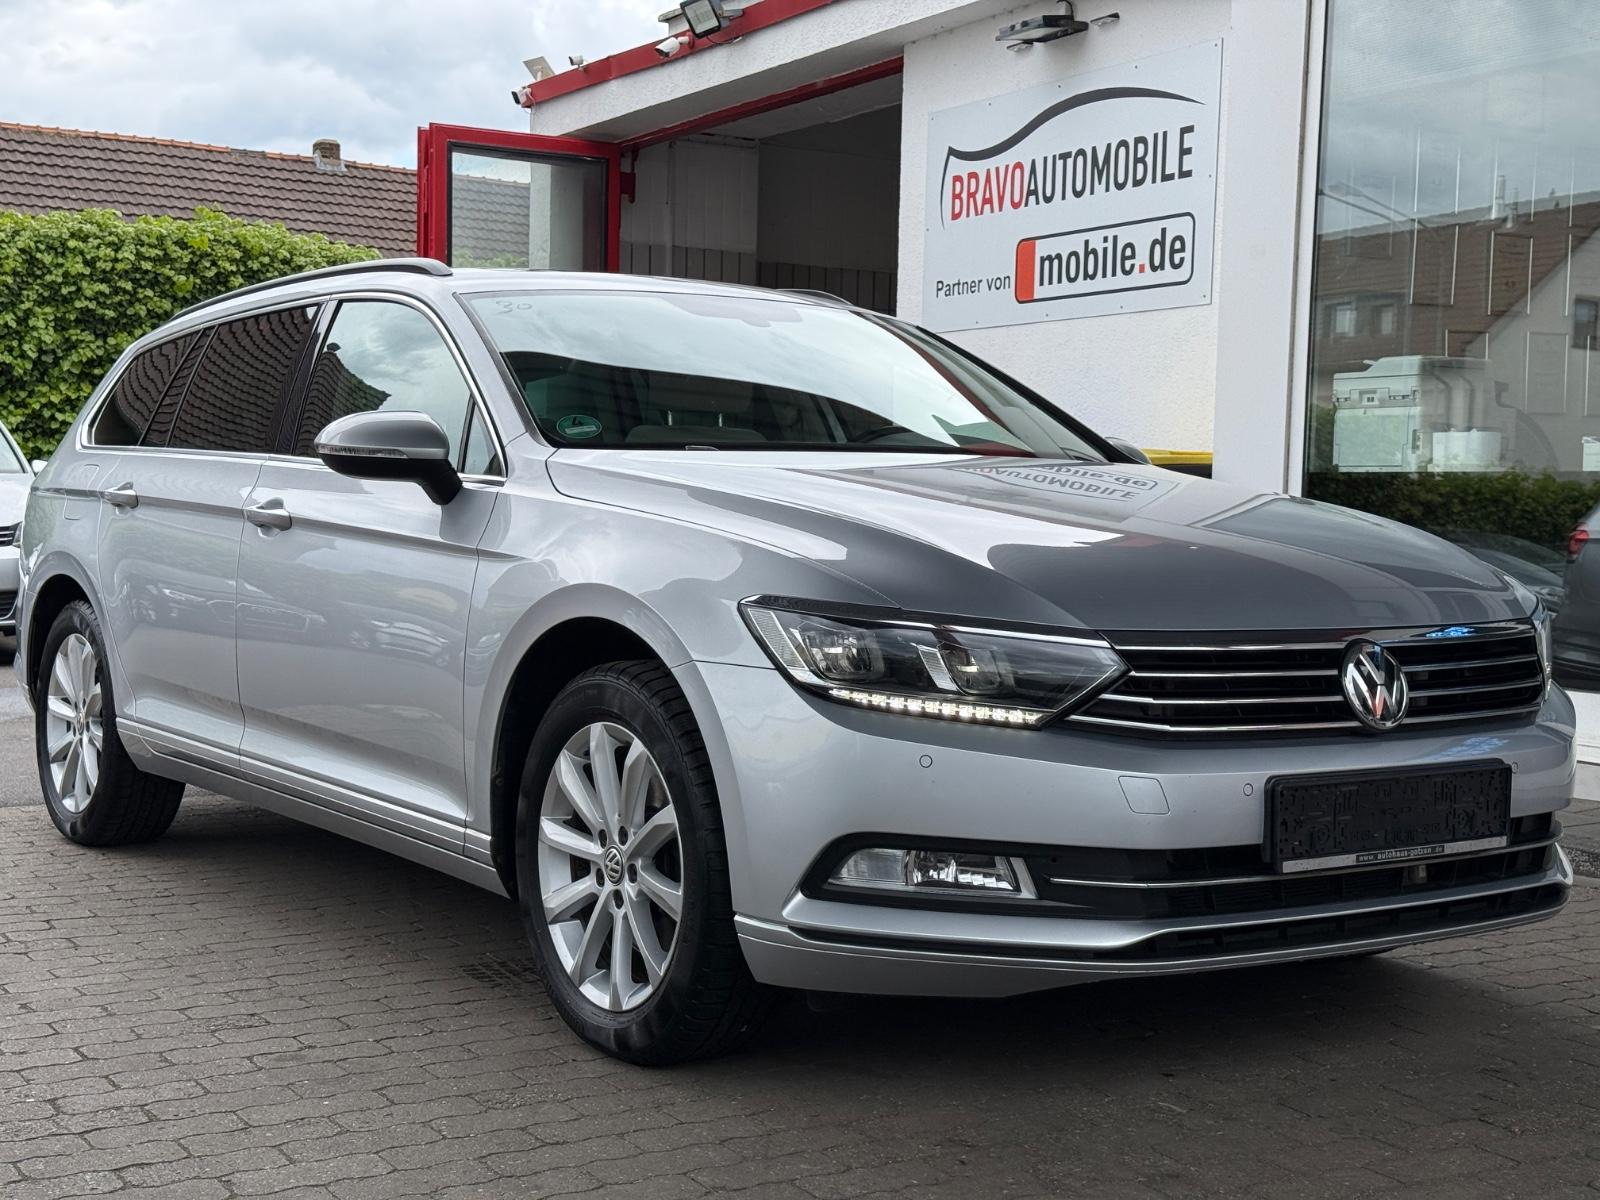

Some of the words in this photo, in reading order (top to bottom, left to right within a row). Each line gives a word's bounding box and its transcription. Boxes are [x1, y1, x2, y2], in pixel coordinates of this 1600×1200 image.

[950, 124, 1195, 221] BRAVOAUTOMOBILE
[935, 277, 982, 299] Partner
[986, 274, 1011, 291] von
[1038, 227, 1187, 287] mobile.de
